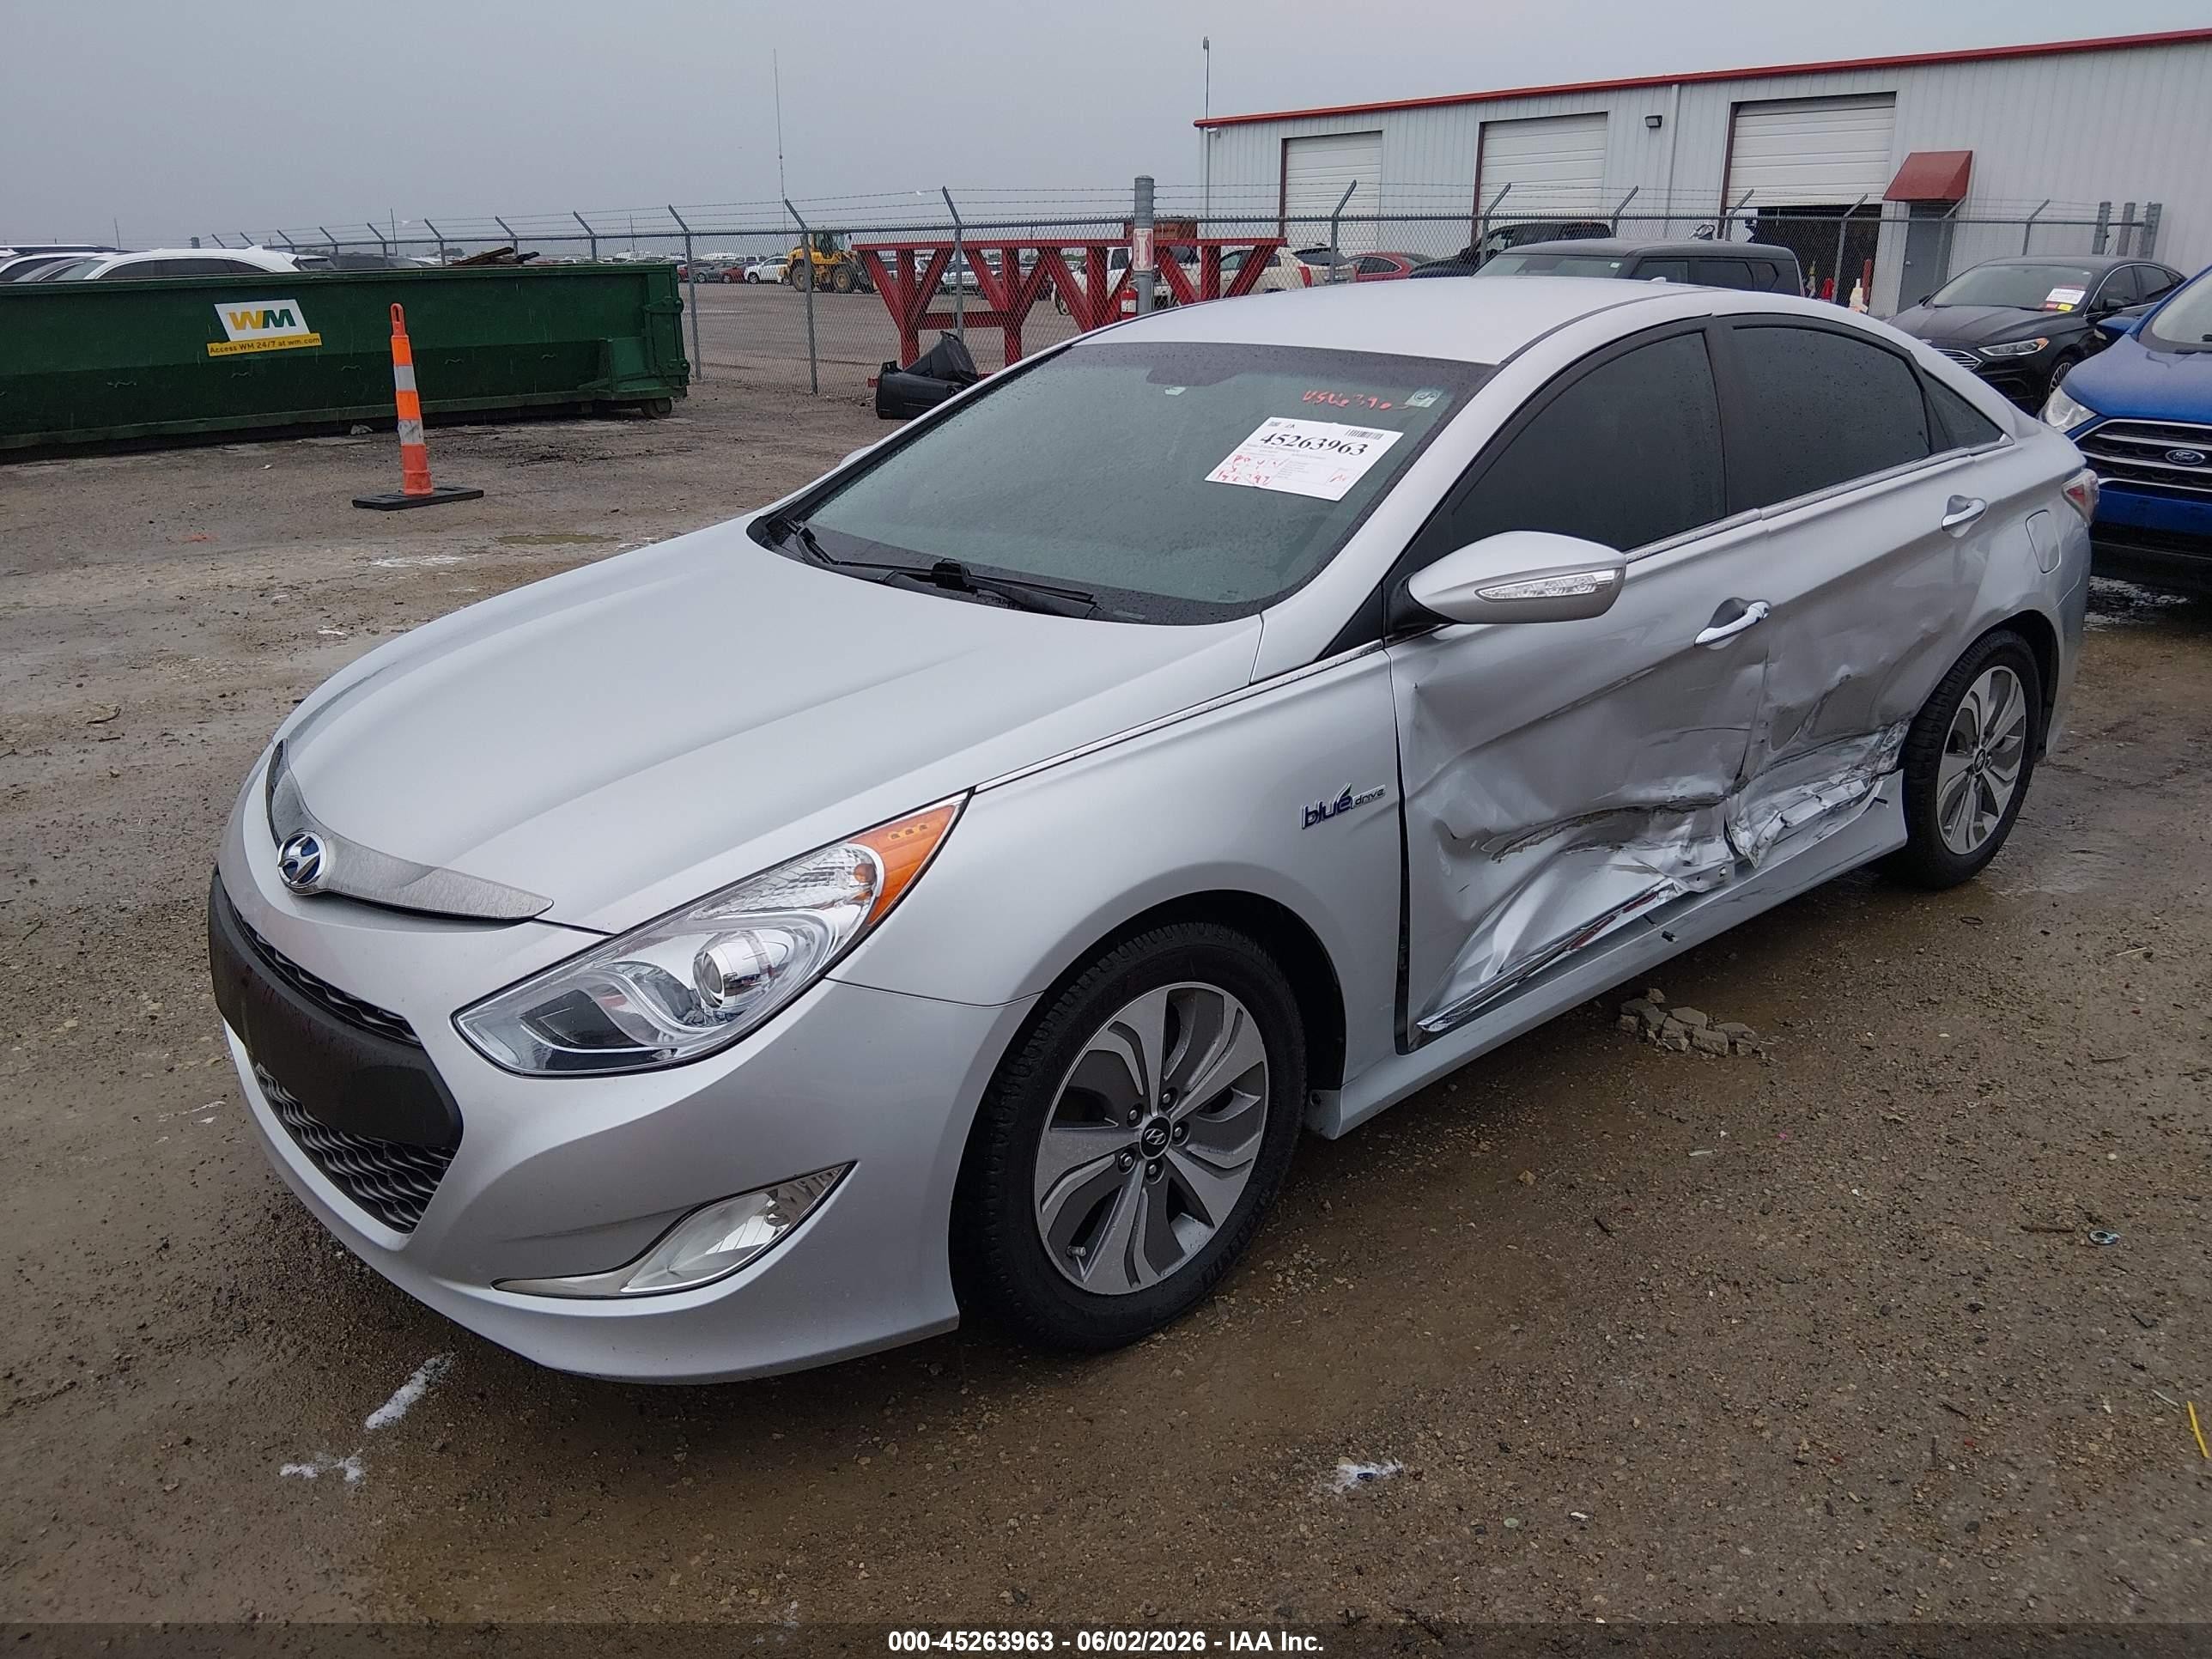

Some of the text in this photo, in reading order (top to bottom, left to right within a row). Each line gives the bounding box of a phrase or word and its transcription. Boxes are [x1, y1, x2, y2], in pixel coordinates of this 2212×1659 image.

[229, 309, 296, 330] WM
[257, 340, 276, 349] 24/7
[1260, 433, 1368, 456] 45263963
[1301, 782, 1385, 830] blue drive
